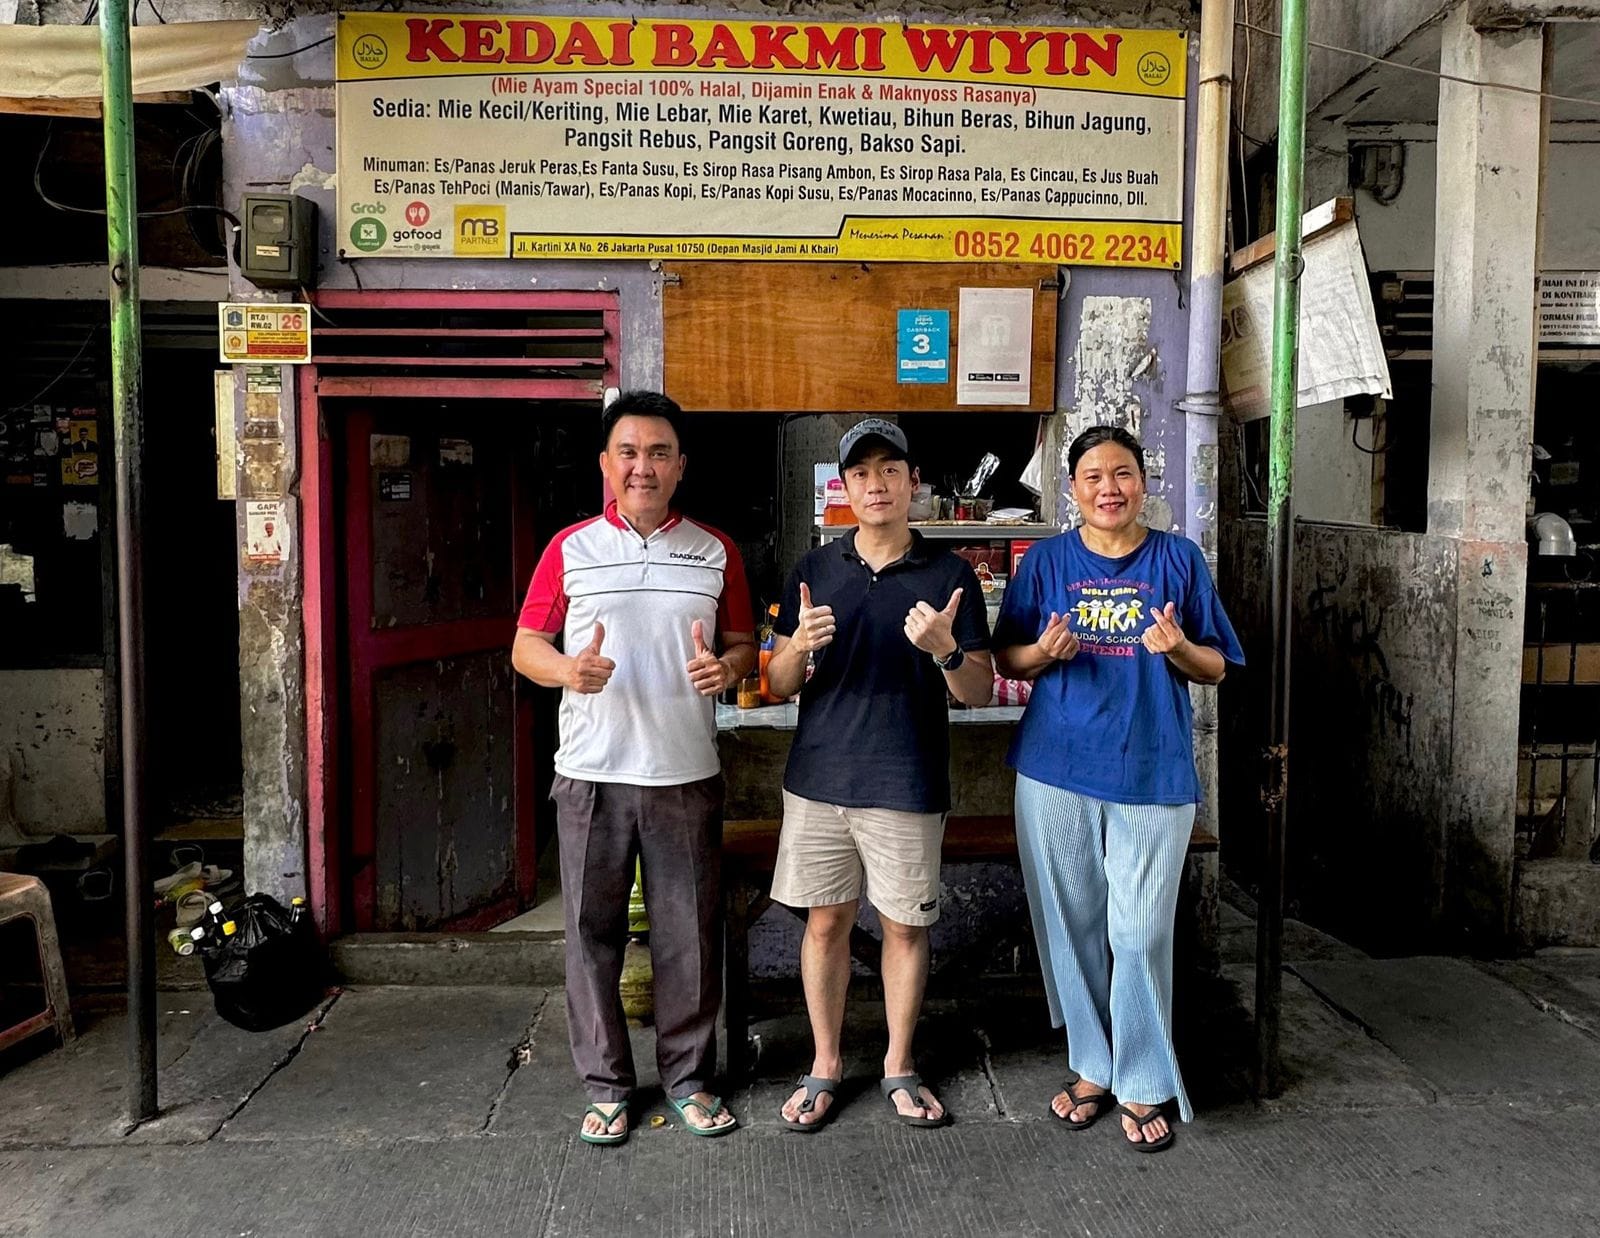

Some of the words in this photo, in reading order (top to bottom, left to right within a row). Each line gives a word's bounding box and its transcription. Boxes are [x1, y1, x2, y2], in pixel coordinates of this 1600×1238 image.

[357, 41, 384, 55] حلال
[407, 19, 633, 65] KEDAI
[651, 24, 886, 71] BAKMI
[903, 28, 1121, 75] WIYIN
[1141, 59, 1167, 72] حلال
[491, 78, 526, 93] (Mie
[534, 79, 578, 96] Ayam
[584, 80, 642, 96] Special
[651, 81, 693, 96] 100%
[700, 82, 746, 101] Halal,
[752, 82, 812, 99] Dijamin
[819, 84, 855, 99] Enak
[862, 85, 872, 99] &
[880, 85, 957, 103] Maknyoss
[963, 87, 1036, 105] Rasanya)
[373, 98, 430, 117] Sedia:
[439, 100, 471, 118] Mie
[480, 100, 608, 124] Kecil/Keriting,
[617, 103, 649, 121] Mie
[657, 103, 711, 125] Lebar,
[720, 104, 751, 123] Mie
[760, 105, 811, 127] Karet,
[820, 106, 896, 129] Kwetiau,
[905, 108, 953, 127] Bihun
[962, 109, 1017, 131] Beras,
[1026, 111, 1074, 129] Bihun
[1081, 112, 1150, 135] Jagung,
[566, 128, 632, 151] Pangsit
[640, 129, 701, 151] Rebus,
[710, 130, 776, 153] Pangsit
[783, 132, 852, 155] Goreng,
[861, 133, 913, 152] Bakso
[922, 134, 965, 157] Sapi.
[364, 157, 428, 172] Minuman:
[435, 158, 495, 173] Es/Panas
[500, 160, 535, 173] Jeruk
[603, 161, 637, 175] Fanta
[643, 161, 678, 177] Susu,
[684, 162, 698, 176] Es
[703, 162, 736, 180] Sirop
[742, 163, 774, 177] Rasa
[780, 164, 822, 182] Pisang
[827, 165, 875, 181] Ambon,
[881, 166, 895, 179] Es
[900, 166, 933, 183] Sirop
[938, 166, 969, 181] Rasa
[975, 167, 1005, 182] Pala,
[1011, 168, 1025, 181] Es
[1031, 168, 1077, 183] Cincau,
[1083, 168, 1096, 183] Es
[1101, 169, 1122, 183] Jus
[1128, 170, 1158, 184] Buah
[375, 179, 435, 194] Es/Panas
[440, 180, 489, 194] TehPoci
[496, 181, 594, 198] (Manis/Tawar),
[600, 182, 659, 198] Es/Panas
[665, 183, 696, 201] Kopi,
[702, 184, 760, 199] Es/Panas
[767, 185, 793, 202] Kopi
[799, 186, 833, 201] Susu,
[839, 186, 897, 201] Es/Panas
[903, 187, 976, 202] Mocacinno,
[982, 188, 1040, 202] Es/Panas
[1046, 188, 1122, 206] Cappucinno,
[1128, 191, 1147, 205] Dll.
[351, 202, 387, 214] Grab
[393, 228, 442, 242] gofood
[531, 242, 561, 252] Kartini
[564, 242, 576, 252] XA
[579, 242, 594, 252] No.
[597, 242, 609, 252] 26
[611, 242, 645, 253] Jakarta
[648, 243, 673, 253] Pusat
[677, 243, 704, 253] 10750
[707, 243, 740, 255] (Depan
[742, 244, 772, 255] Masjid
[775, 244, 796, 254] Jami
[799, 244, 808, 254] Al
[811, 244, 839, 255] Khair)
[850, 228, 898, 240] Menerima
[902, 228, 944, 240] Pesanan
[955, 231, 1019, 257] 0852
[1030, 234, 1094, 260] 4062
[1105, 235, 1168, 262] 2234
[282, 314, 302, 330] 26
[912, 334, 930, 354] 3
[669, 552, 707, 562] DIADORA
[1105, 635, 1144, 644] SCHOO
[1080, 642, 1134, 656] ETESDA
